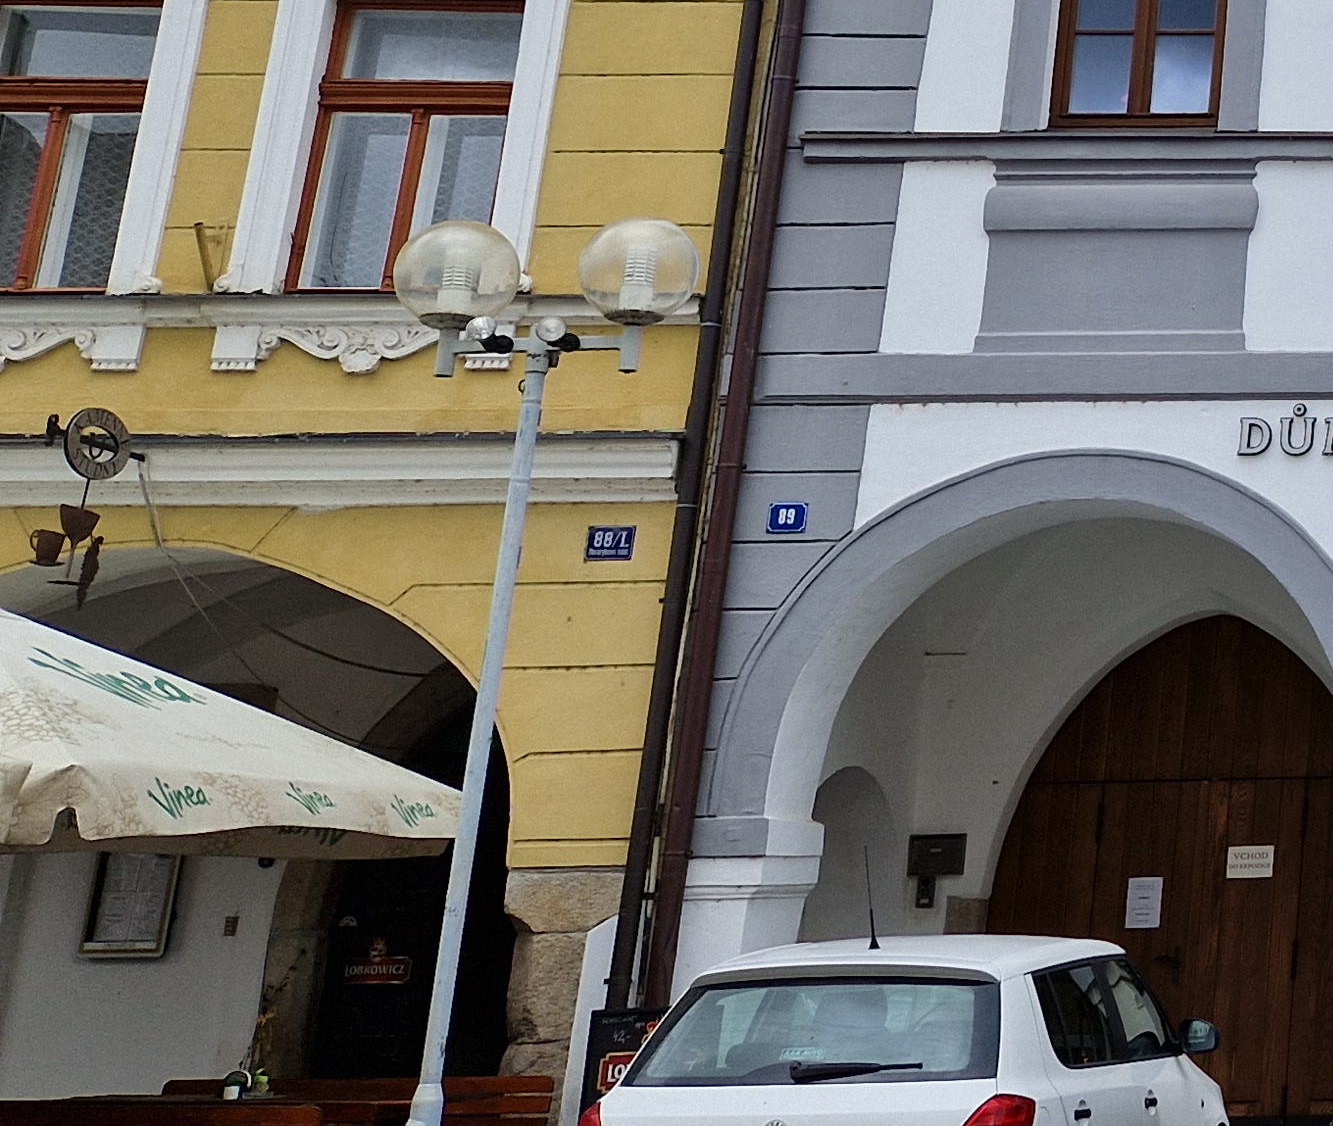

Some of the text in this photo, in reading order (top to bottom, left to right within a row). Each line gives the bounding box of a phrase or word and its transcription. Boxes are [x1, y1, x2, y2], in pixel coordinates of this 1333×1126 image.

[778, 508, 796, 524] 89
[27, 646, 207, 711] Vinea
[147, 776, 210, 820] Vinea
[286, 781, 336, 816] Vinea
[391, 793, 437, 828] Vinea
[1233, 852, 1269, 860] VCHOD
[344, 964, 405, 977] LOBKOWICZ
[607, 1063, 630, 1082] LO
